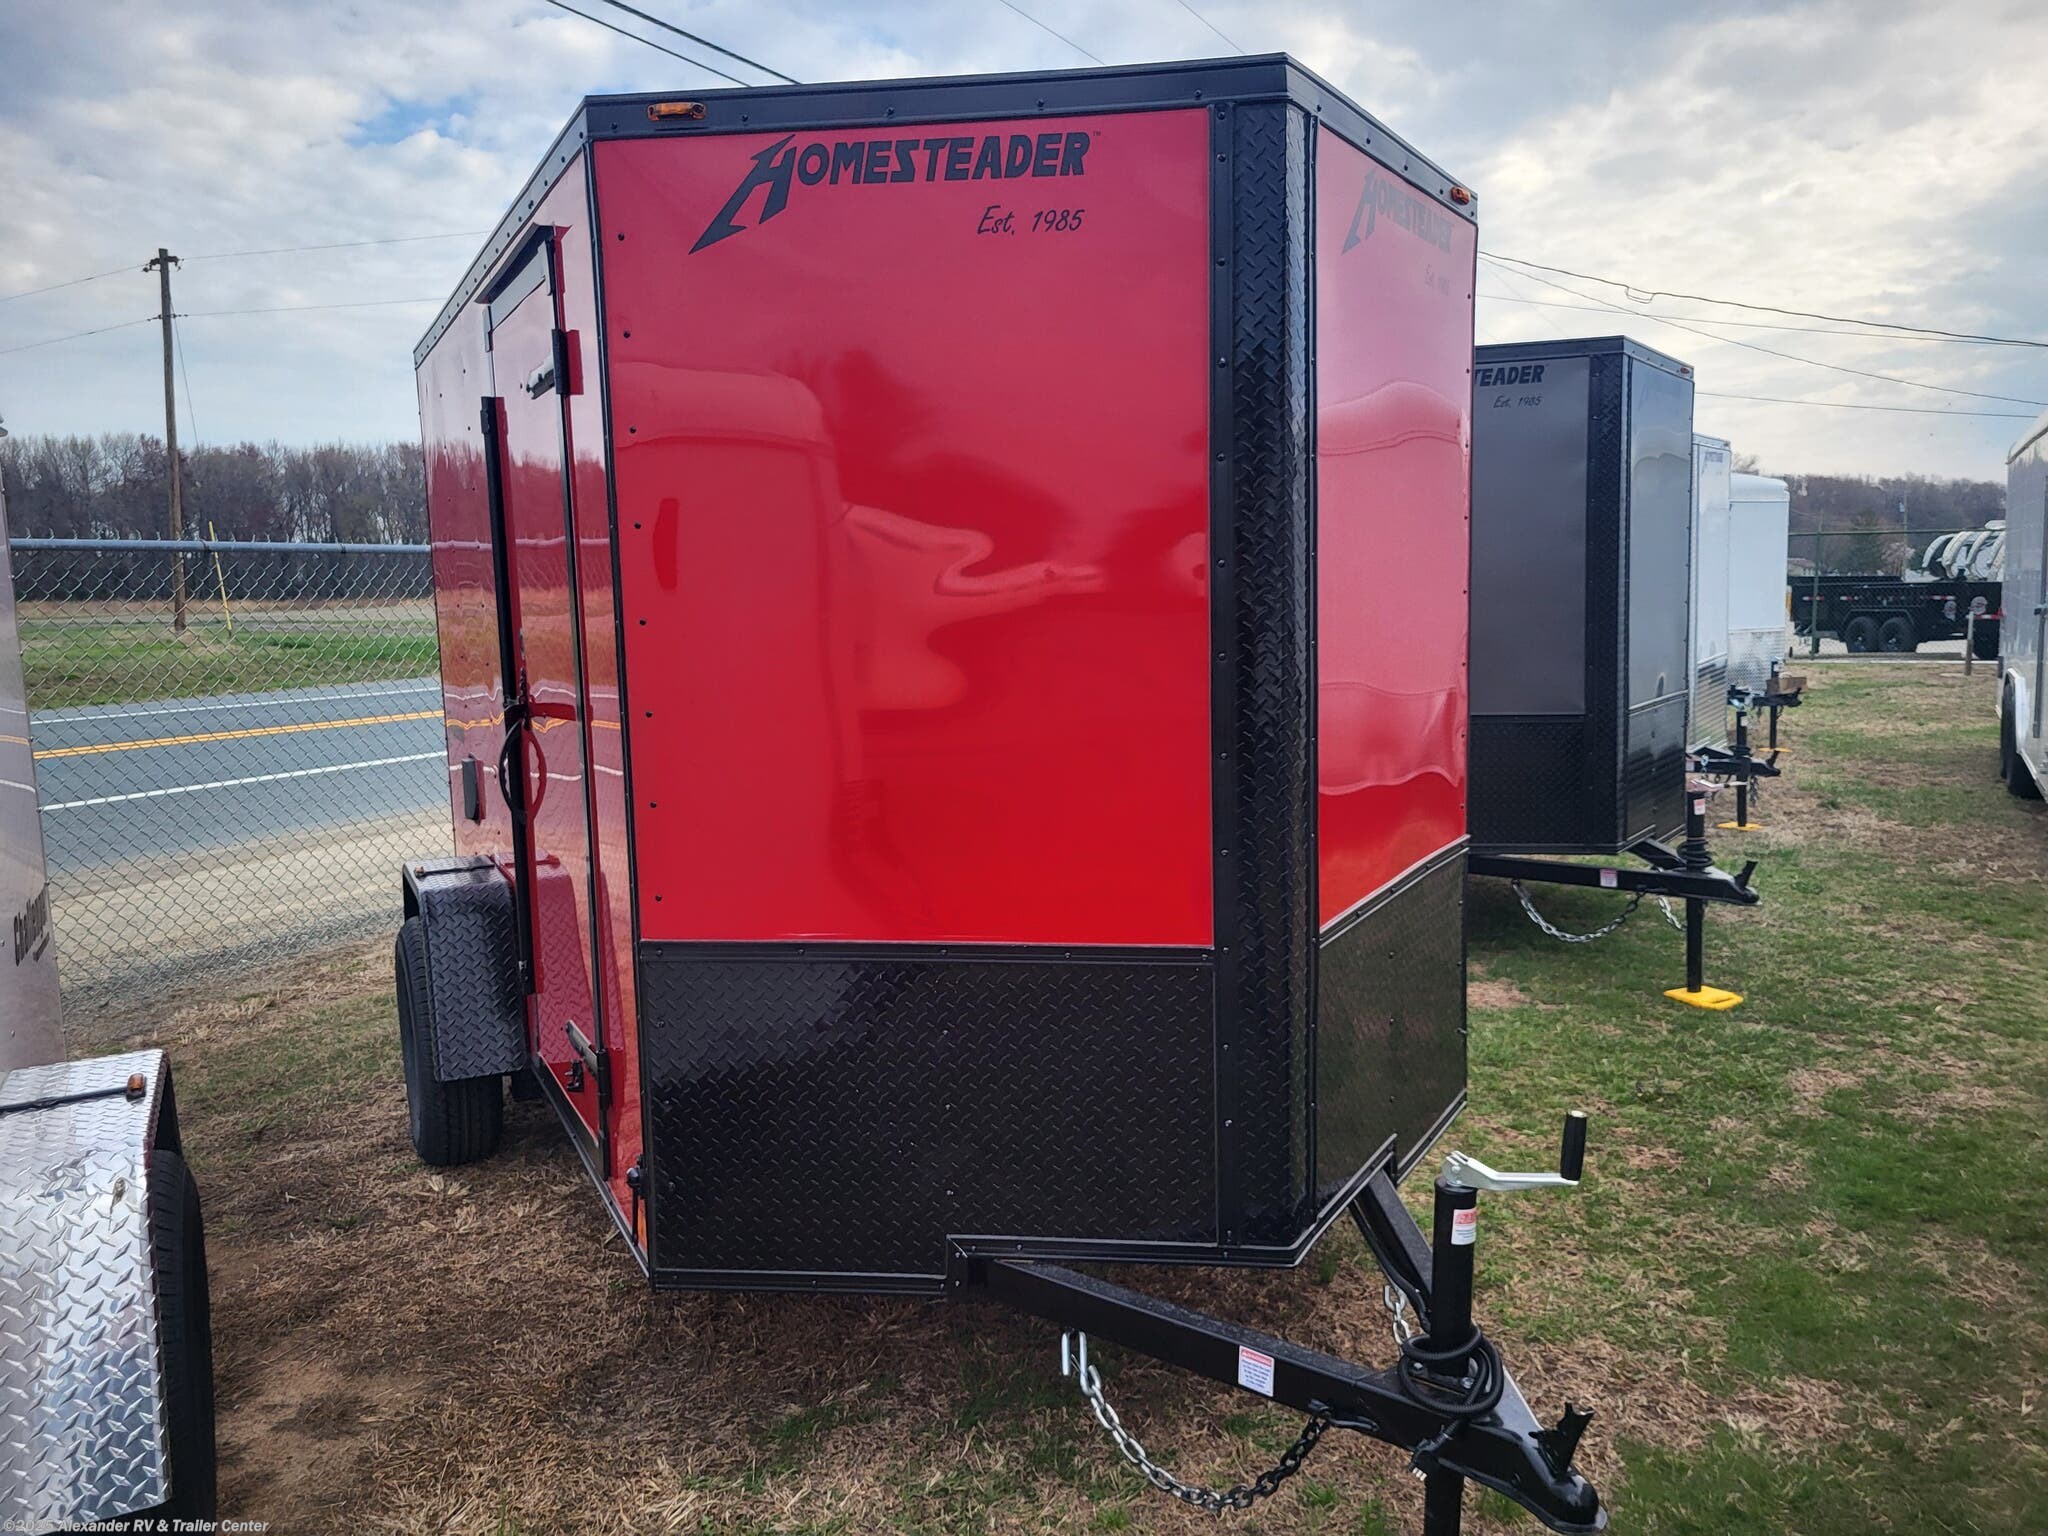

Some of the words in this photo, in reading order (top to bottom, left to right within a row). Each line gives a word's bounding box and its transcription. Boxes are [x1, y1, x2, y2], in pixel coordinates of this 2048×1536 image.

[688, 132, 1090, 255] HOMESTEADER
[977, 205, 1015, 236] Est.
[1031, 208, 1086, 233] 1985
